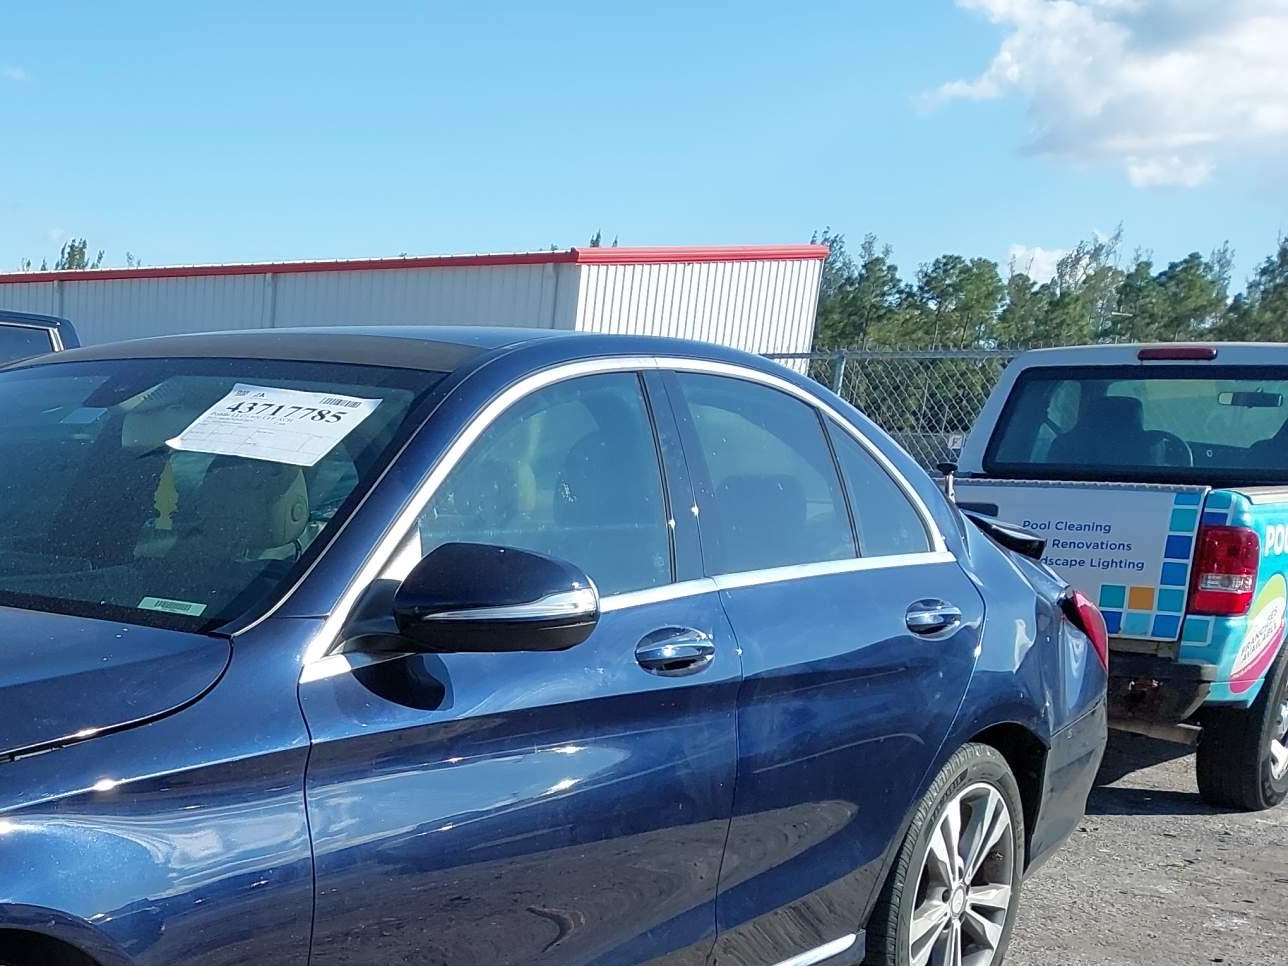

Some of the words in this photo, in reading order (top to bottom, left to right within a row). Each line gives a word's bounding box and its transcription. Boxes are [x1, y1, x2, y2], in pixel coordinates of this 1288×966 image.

[226, 400, 348, 424] 43717785
[1022, 520, 1051, 530] Pool
[1055, 521, 1112, 534] Cleaning
[1052, 538, 1132, 552] Renovations
[1040, 555, 1086, 568] dscape
[1090, 557, 1145, 571] Lighting
